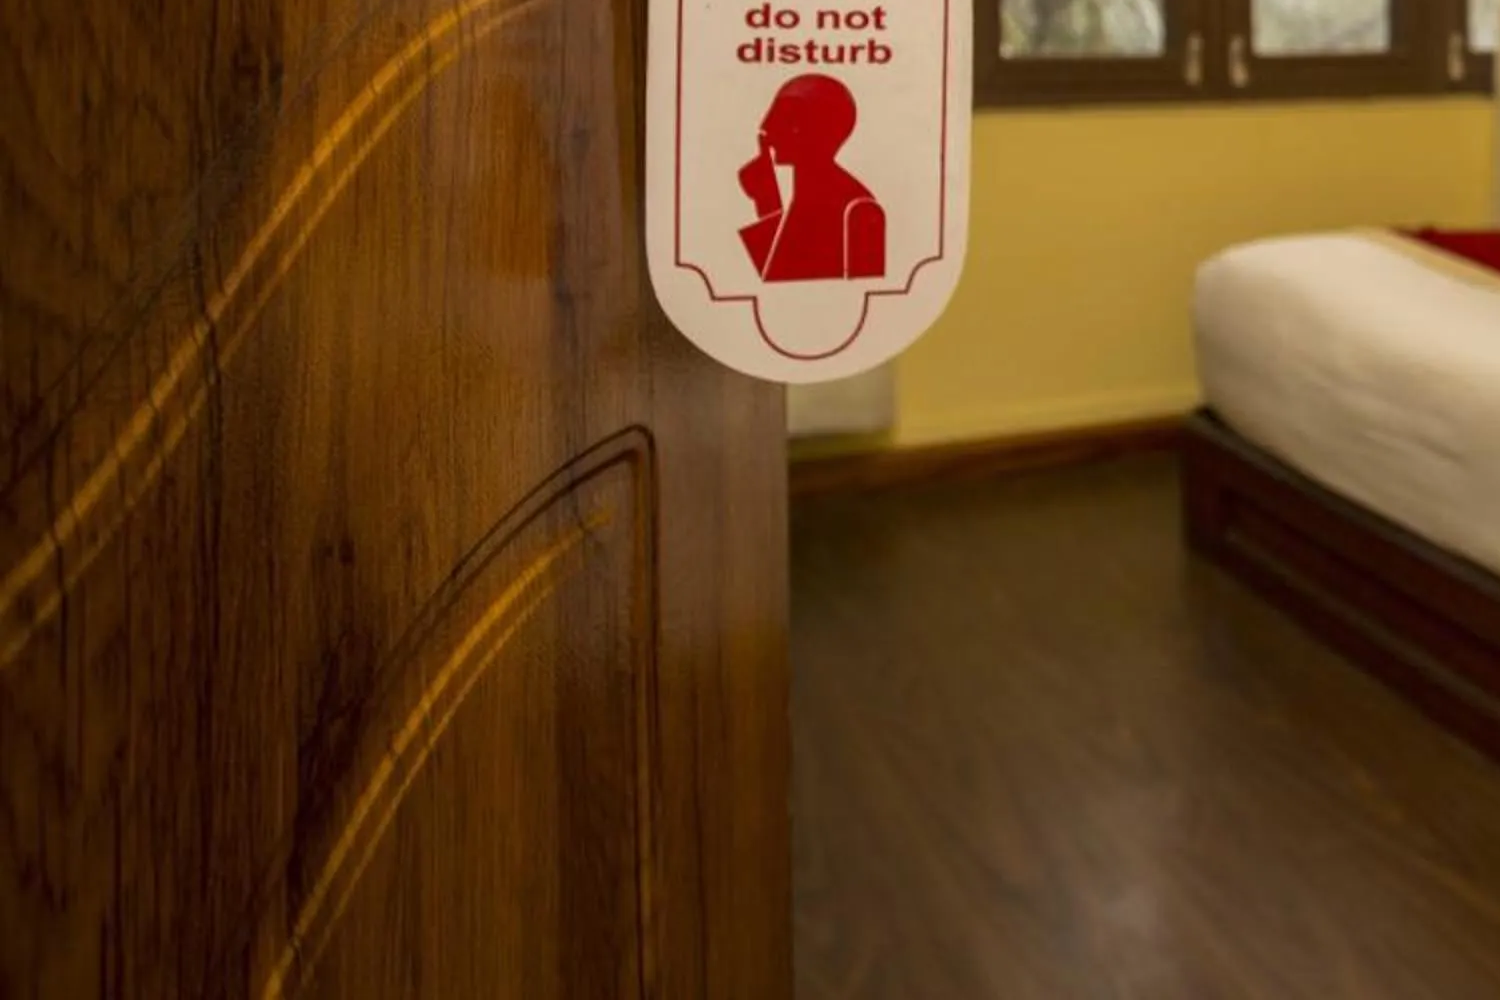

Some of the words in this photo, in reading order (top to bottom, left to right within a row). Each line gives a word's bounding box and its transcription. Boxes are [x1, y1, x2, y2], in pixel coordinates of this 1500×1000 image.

[745, 3, 800, 29] do
[816, 6, 887, 30] not
[736, 37, 893, 64] disturb
